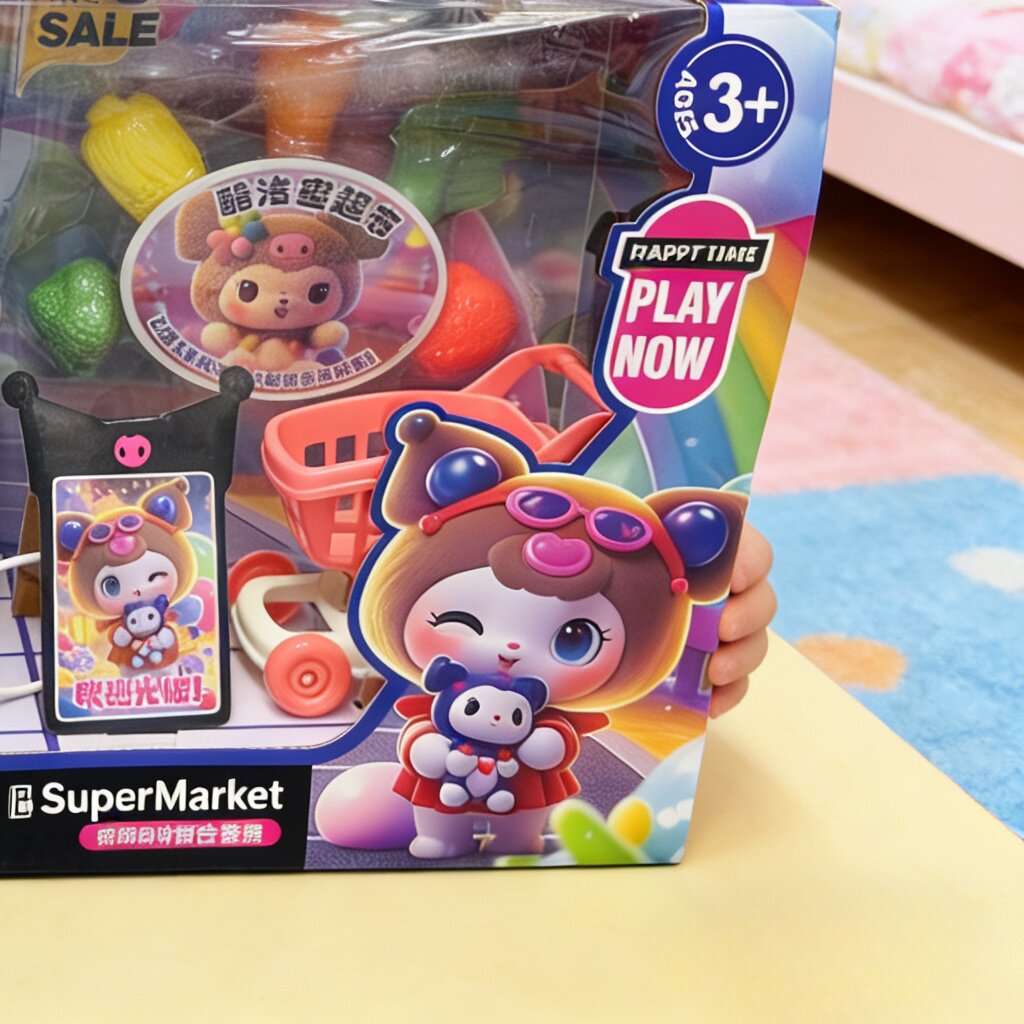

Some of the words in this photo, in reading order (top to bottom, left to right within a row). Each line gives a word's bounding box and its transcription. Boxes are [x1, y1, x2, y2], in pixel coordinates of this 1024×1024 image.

[37, 11, 160, 48] SALE
[703, 71, 779, 134] 3+
[625, 277, 735, 325] PLAY
[612, 333, 715, 381] NOW
[40, 778, 284, 822] SuperMarket
